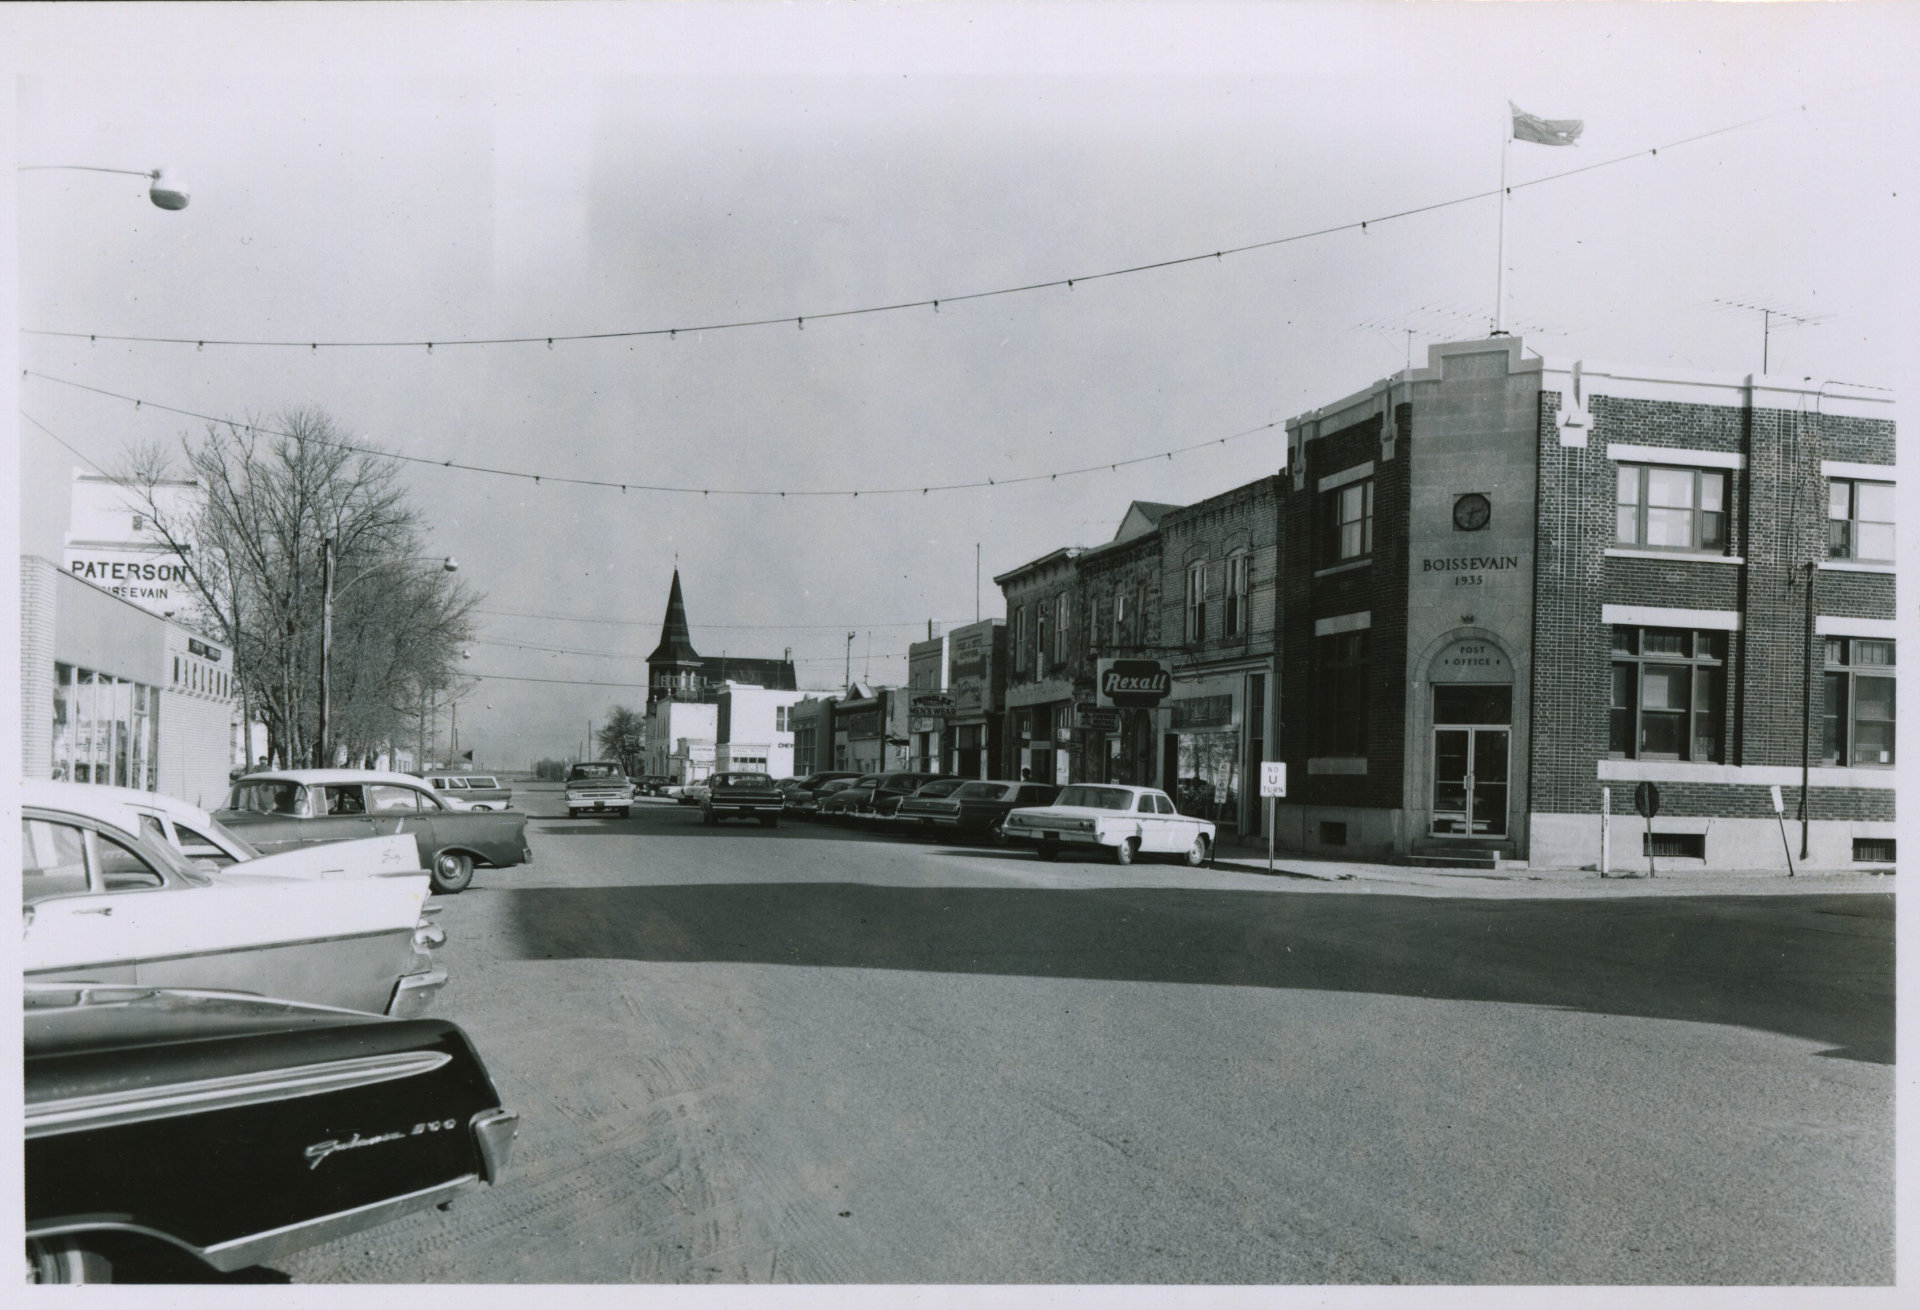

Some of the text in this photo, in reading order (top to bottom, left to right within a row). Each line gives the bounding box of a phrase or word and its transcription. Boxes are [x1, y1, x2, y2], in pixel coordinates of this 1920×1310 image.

[1423, 556, 1518, 572] BOISSEVAIN
[71, 560, 187, 583] PATERSON
[1455, 575, 1483, 586] 1935
[1460, 646, 1485, 654] POST
[1453, 658, 1491, 666] OFFICE
[1104, 673, 1167, 693] Rexall
[934, 706, 957, 716] WEAR
[1268, 775, 1278, 785] U
[410, 1118, 457, 1136] 500
